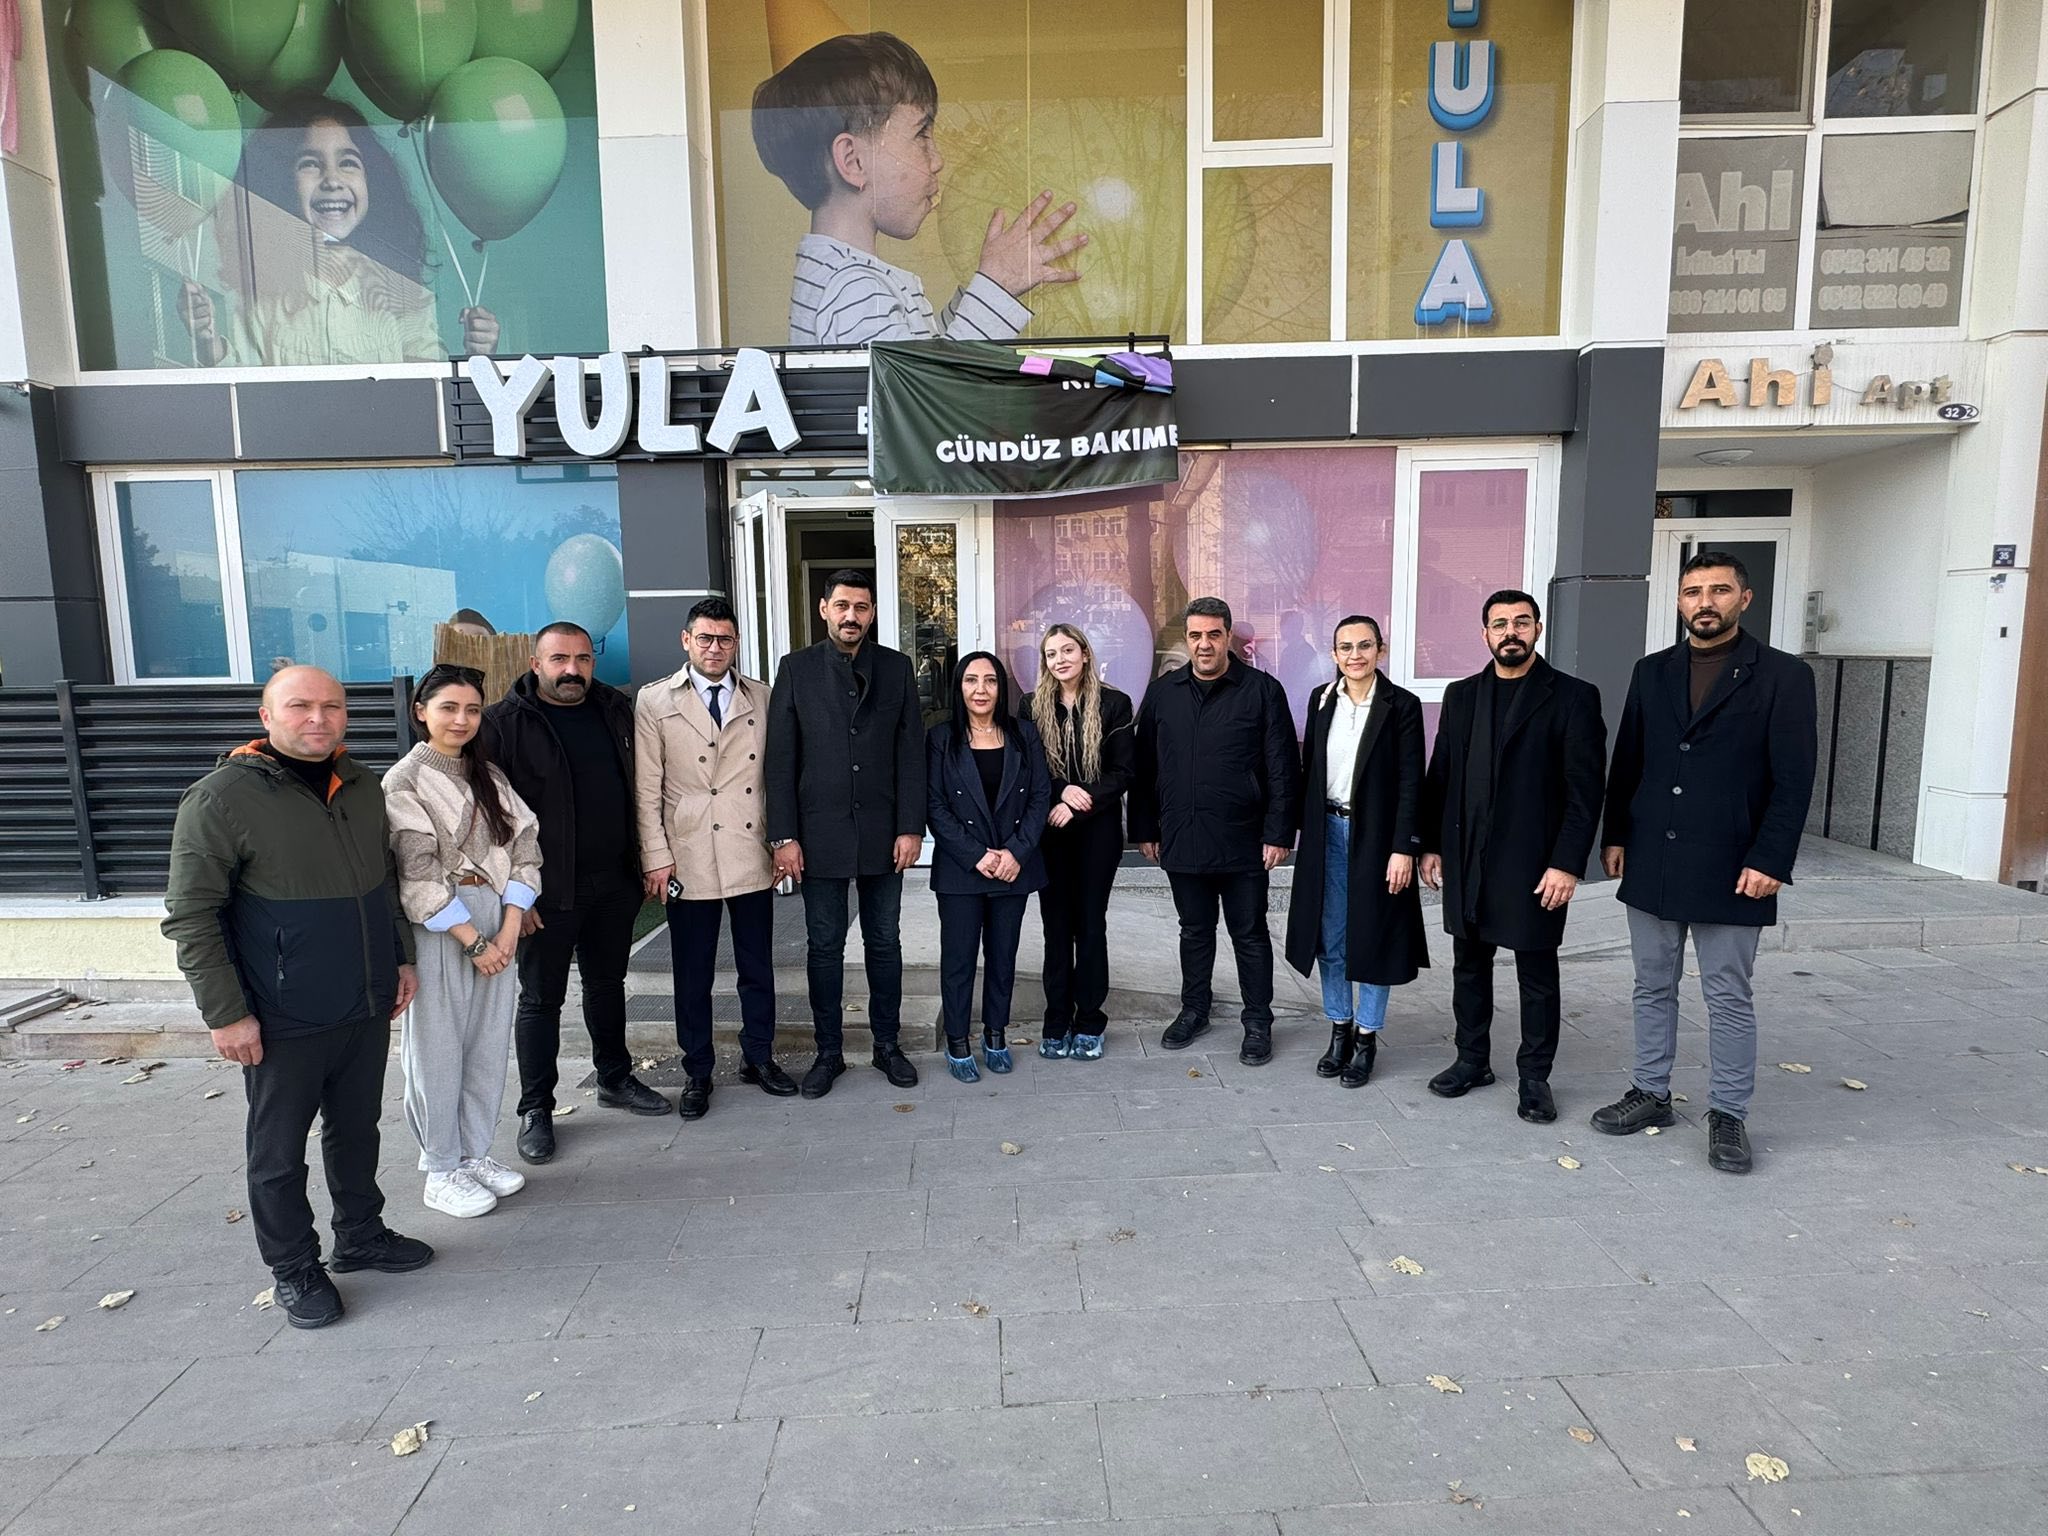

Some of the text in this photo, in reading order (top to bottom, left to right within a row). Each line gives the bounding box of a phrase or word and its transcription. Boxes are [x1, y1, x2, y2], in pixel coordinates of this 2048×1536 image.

[1674, 170, 1794, 233] Ahi
[1738, 288, 1761, 313] 01
[1679, 343, 1953, 412] Ahi Apt
[468, 347, 802, 458] YULA
[1943, 407, 1960, 419] 32
[935, 433, 1061, 463] GÜNDÜZ
